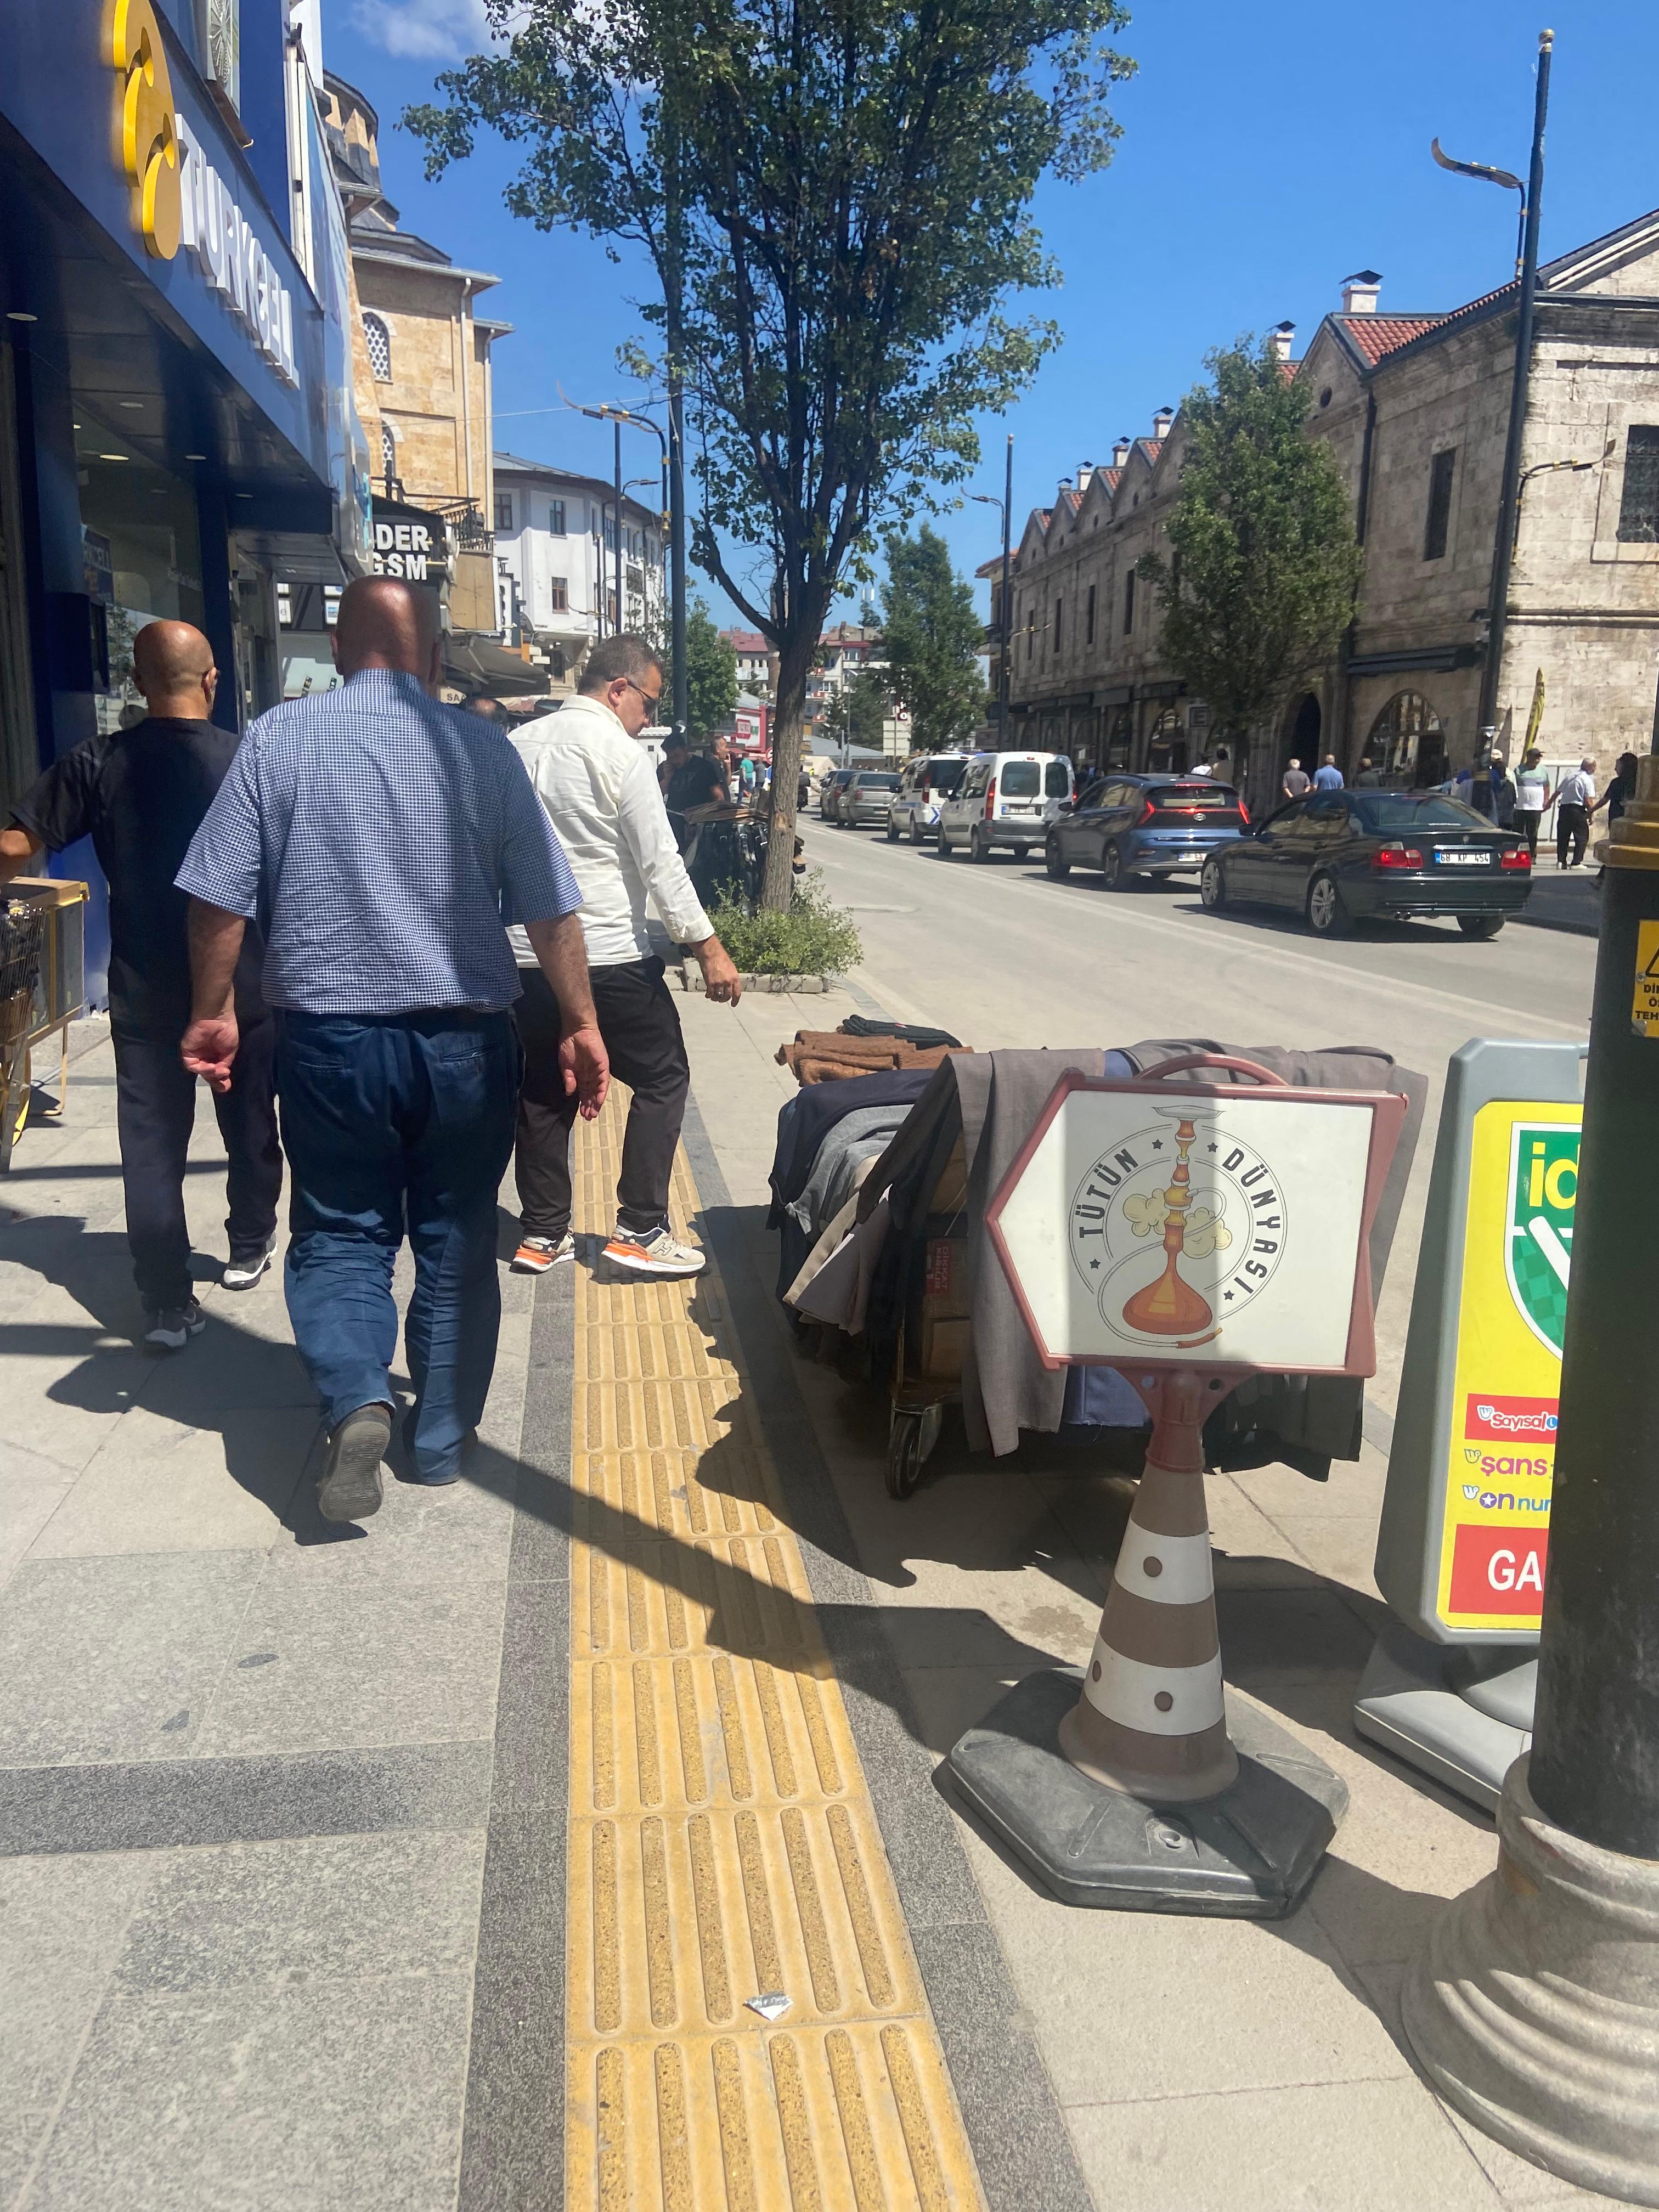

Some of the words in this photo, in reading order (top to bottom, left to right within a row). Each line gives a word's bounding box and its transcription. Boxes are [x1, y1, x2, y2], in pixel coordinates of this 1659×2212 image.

[175, 113, 300, 391] TURKCELL
[373, 524, 430, 552] DER
[373, 552, 427, 580] GSM
[1475, 853, 1488, 862] 454
[1649, 996, 1659, 1007] Ö
[1075, 1148, 1138, 1238] TÜTÜN
[1222, 1148, 1280, 1294] DÜNYASI
[1480, 1457, 1548, 1477] şans
[1487, 1549, 1543, 1591] GA
